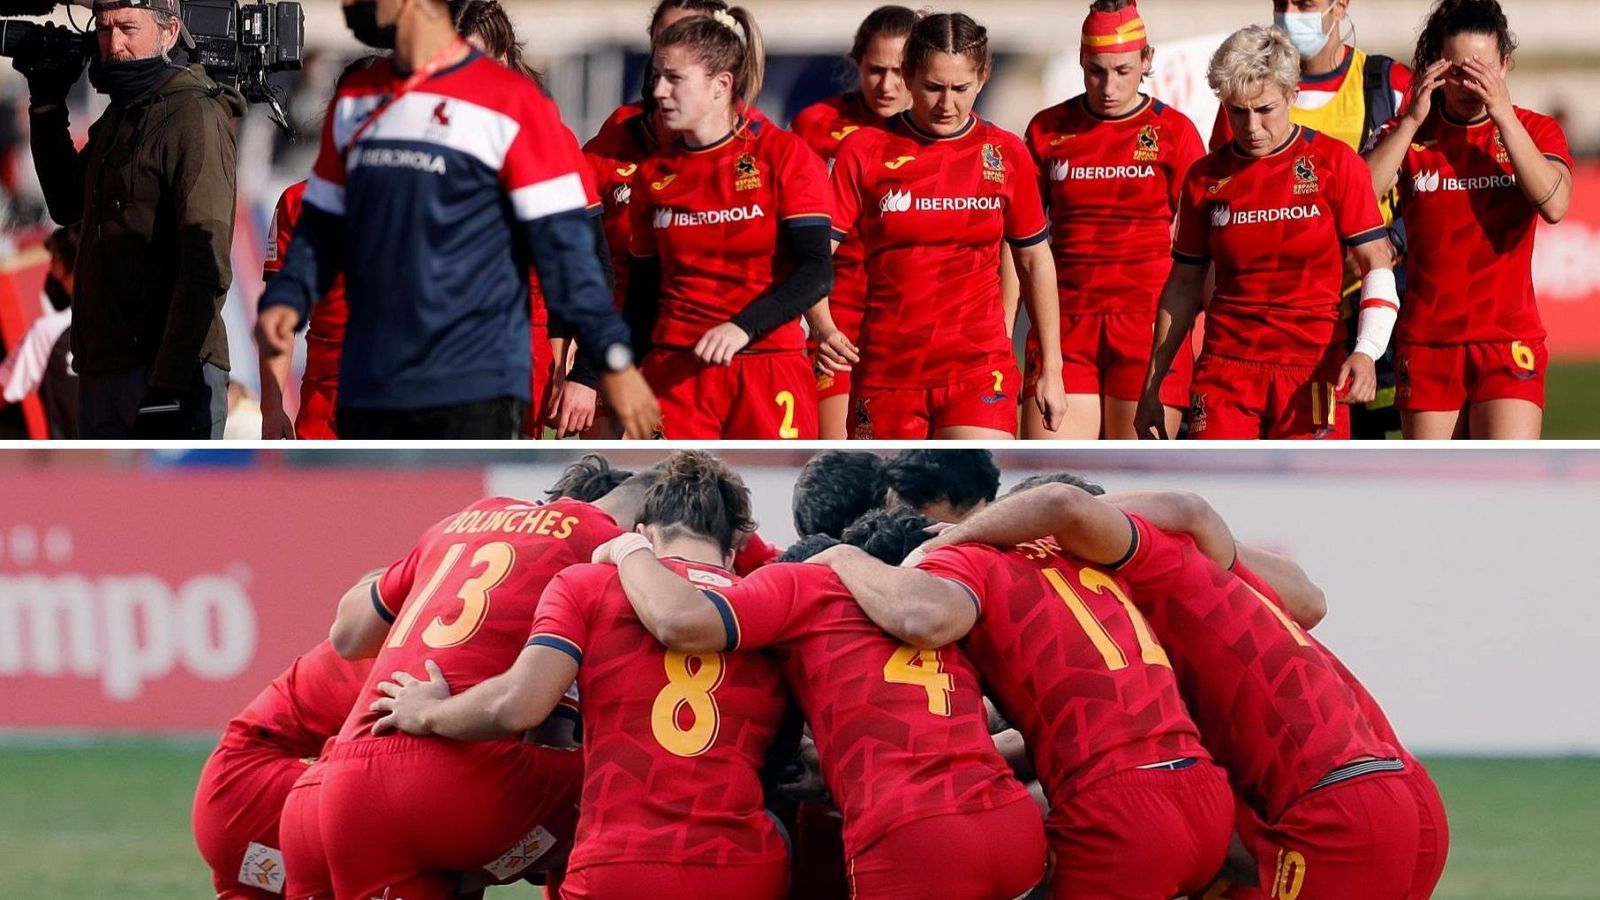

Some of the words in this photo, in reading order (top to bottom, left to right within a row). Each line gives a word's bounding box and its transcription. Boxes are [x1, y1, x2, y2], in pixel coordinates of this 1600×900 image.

[1071, 165, 1155, 180] IBERDROLA
[674, 204, 764, 227] IBERDROLA
[915, 196, 1001, 210] IBERDROLA
[1233, 203, 1321, 224] IBERDROLA
[1511, 340, 1535, 371] 6
[775, 390, 799, 439] 2
[1311, 381, 1336, 425] 11
[443, 509, 580, 540] BOLINCHES
[386, 541, 516, 649] 13
[1041, 566, 1174, 671] 12
[883, 645, 956, 717] 4
[651, 649, 726, 758] 8
